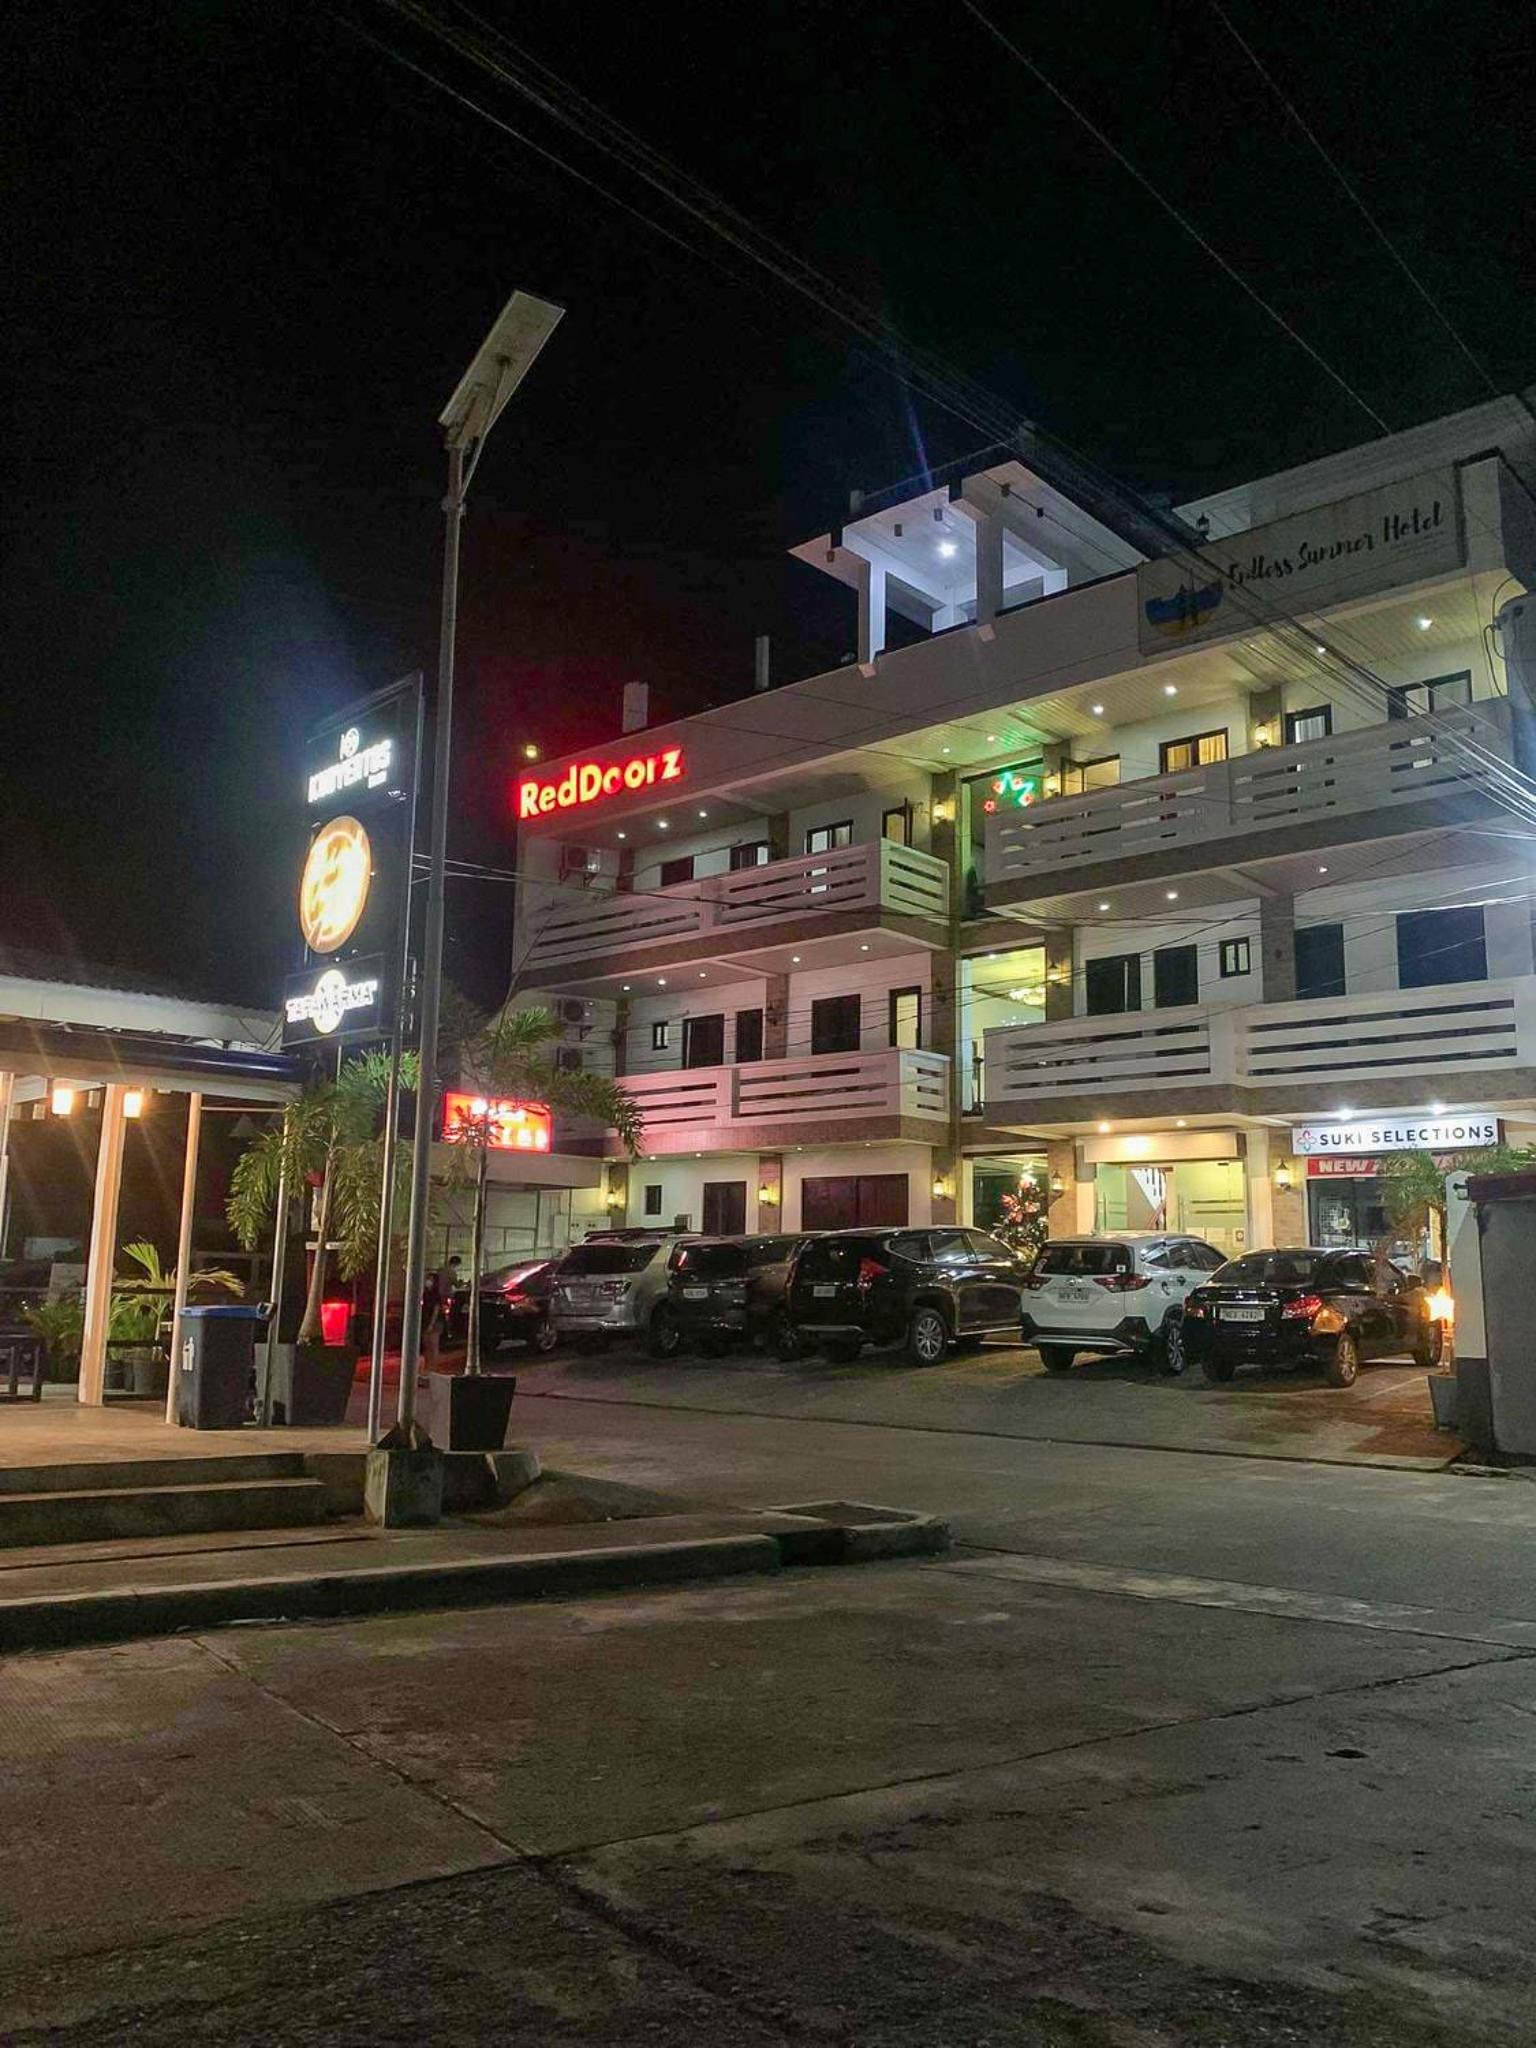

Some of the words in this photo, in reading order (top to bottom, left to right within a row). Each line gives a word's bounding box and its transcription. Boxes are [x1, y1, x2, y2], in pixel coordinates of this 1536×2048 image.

[1297, 532, 1375, 571] Summer
[1383, 501, 1442, 543] Hotel
[519, 749, 682, 819] RedDoorz
[1319, 1132, 1362, 1146] SUKI
[1371, 1125, 1494, 1143] SELECTIONS
[1318, 1158, 1369, 1173] NEW
